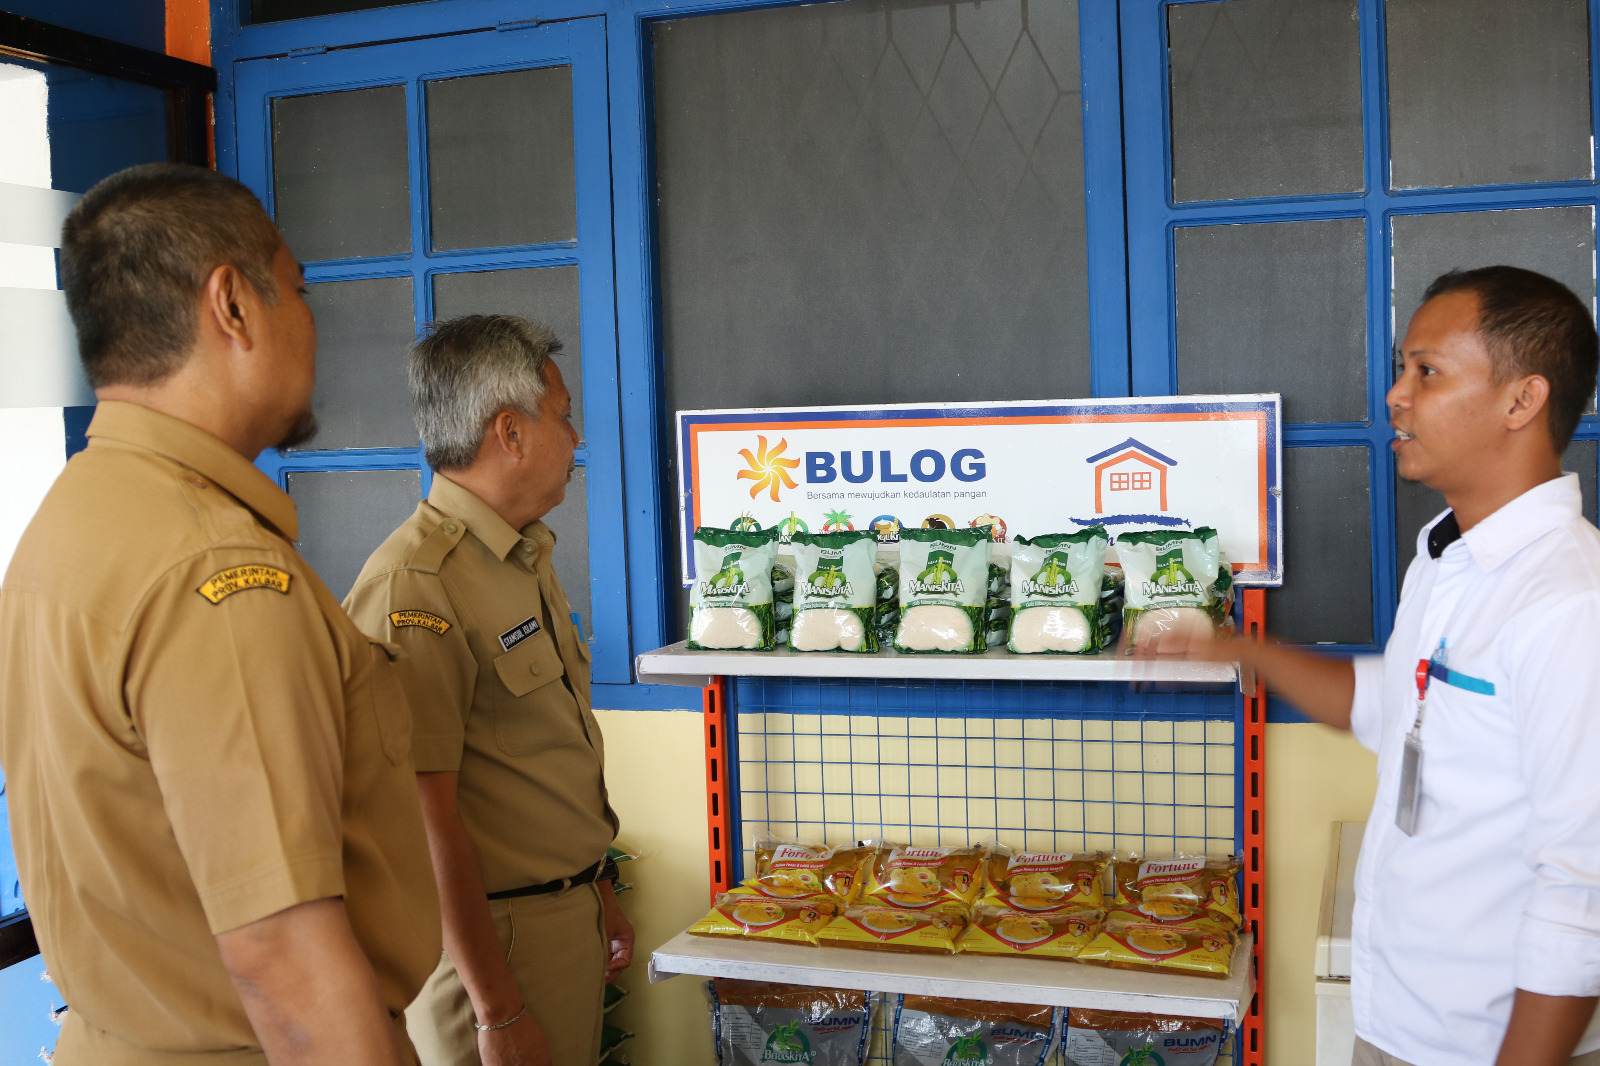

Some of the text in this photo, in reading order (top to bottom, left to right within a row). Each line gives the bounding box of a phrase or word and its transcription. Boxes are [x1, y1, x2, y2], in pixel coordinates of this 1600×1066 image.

[805, 448, 987, 484] BULOG
[806, 489, 987, 501] Bersama mewujudkan kedaulatan pangan
[210, 567, 279, 588] PEMERINTAH
[243, 577, 283, 592] KALBAR
[399, 611, 443, 626] PEMERINTAH
[780, 847, 828, 859] Fortue
[1015, 853, 1067, 864] Fortune
[1146, 862, 1199, 874] Fortune
[1163, 1034, 1217, 1048] BUMN
